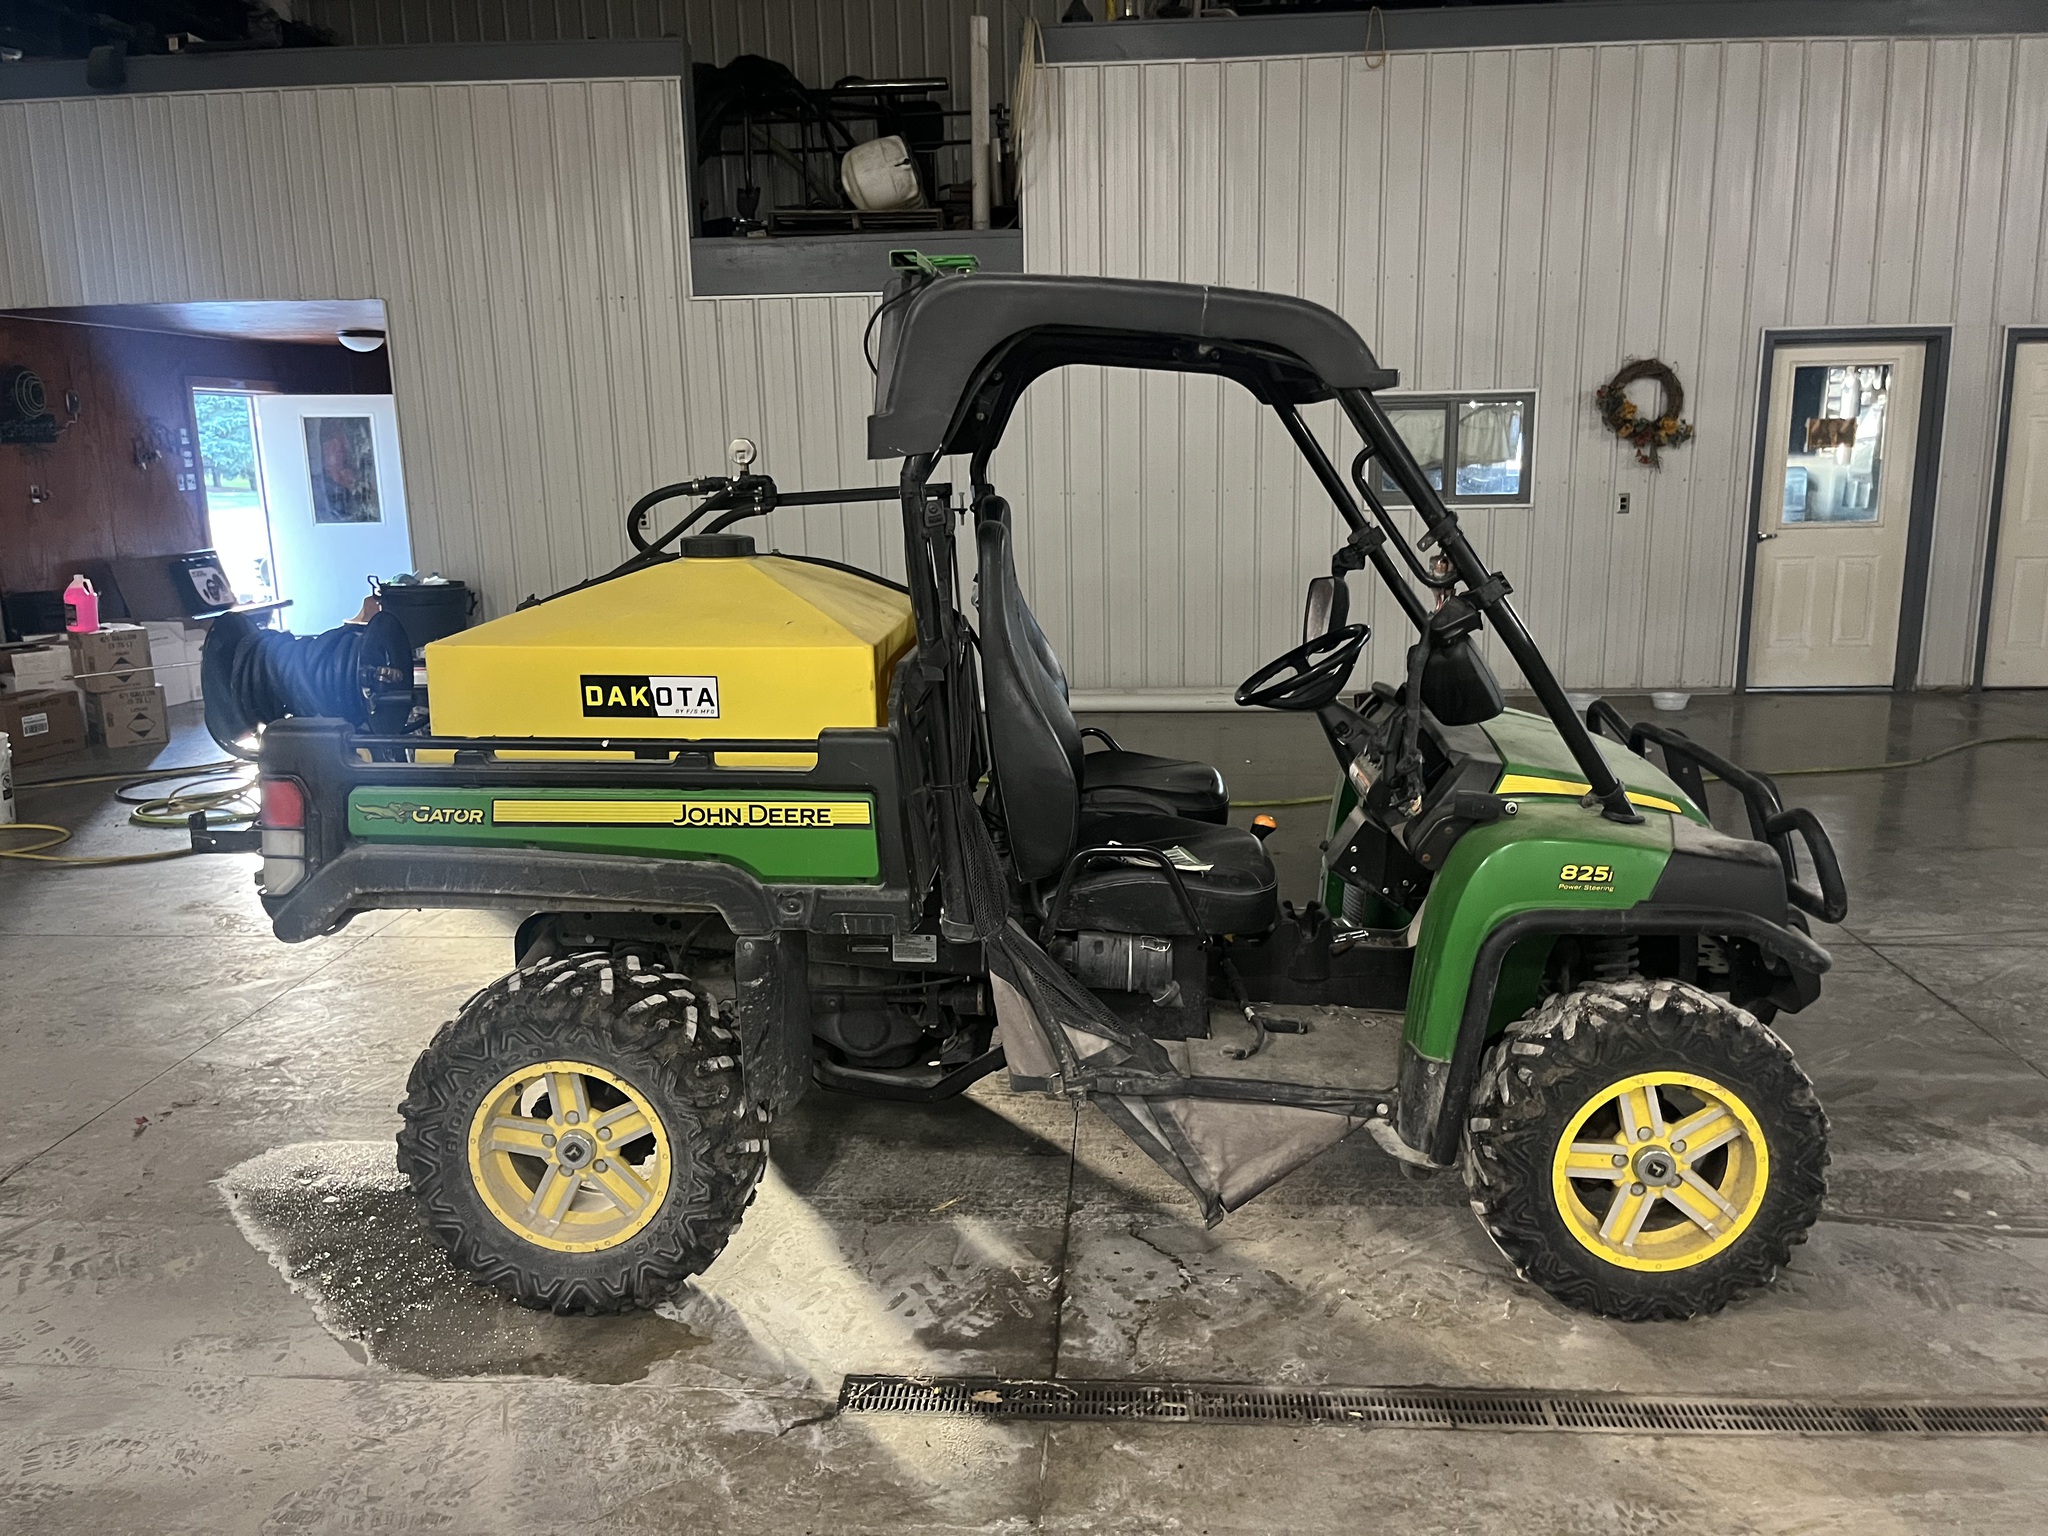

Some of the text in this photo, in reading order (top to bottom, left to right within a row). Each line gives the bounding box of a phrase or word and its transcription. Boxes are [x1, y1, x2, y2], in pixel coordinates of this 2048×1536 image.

[585, 685, 715, 707] DAKOTA
[411, 806, 485, 825] GATOR
[673, 803, 833, 827] JOHN DEERE
[1558, 883, 1614, 893] Power Steering
[445, 1063, 502, 1154] BIGHORN
[634, 1171, 688, 1257] MAXXIS
